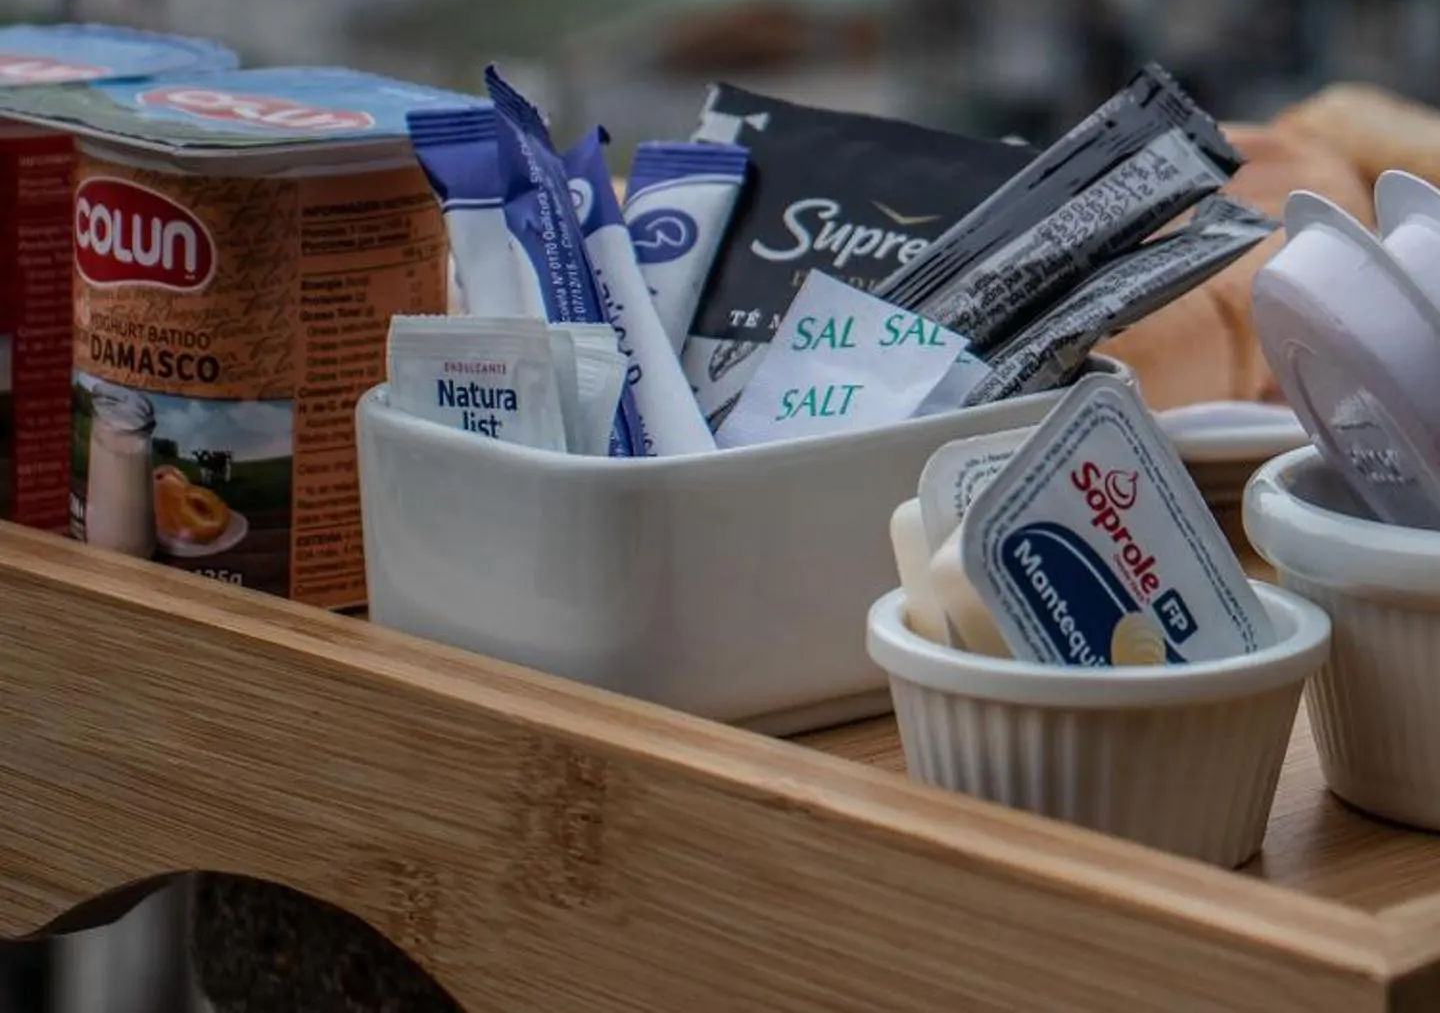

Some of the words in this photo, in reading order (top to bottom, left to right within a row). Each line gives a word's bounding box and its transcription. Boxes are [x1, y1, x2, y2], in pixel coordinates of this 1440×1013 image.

[76, 197, 197, 273] COLUN
[752, 198, 929, 268] Supre
[148, 326, 211, 350] BATIDO
[792, 316, 856, 351] SAL
[879, 314, 947, 346] SAL
[91, 334, 220, 383] DAMASCO
[437, 379, 517, 411] Natura
[775, 385, 864, 421] SALT
[1071, 462, 1159, 595] Soprole
[1013, 539, 1106, 667] Mantequ
